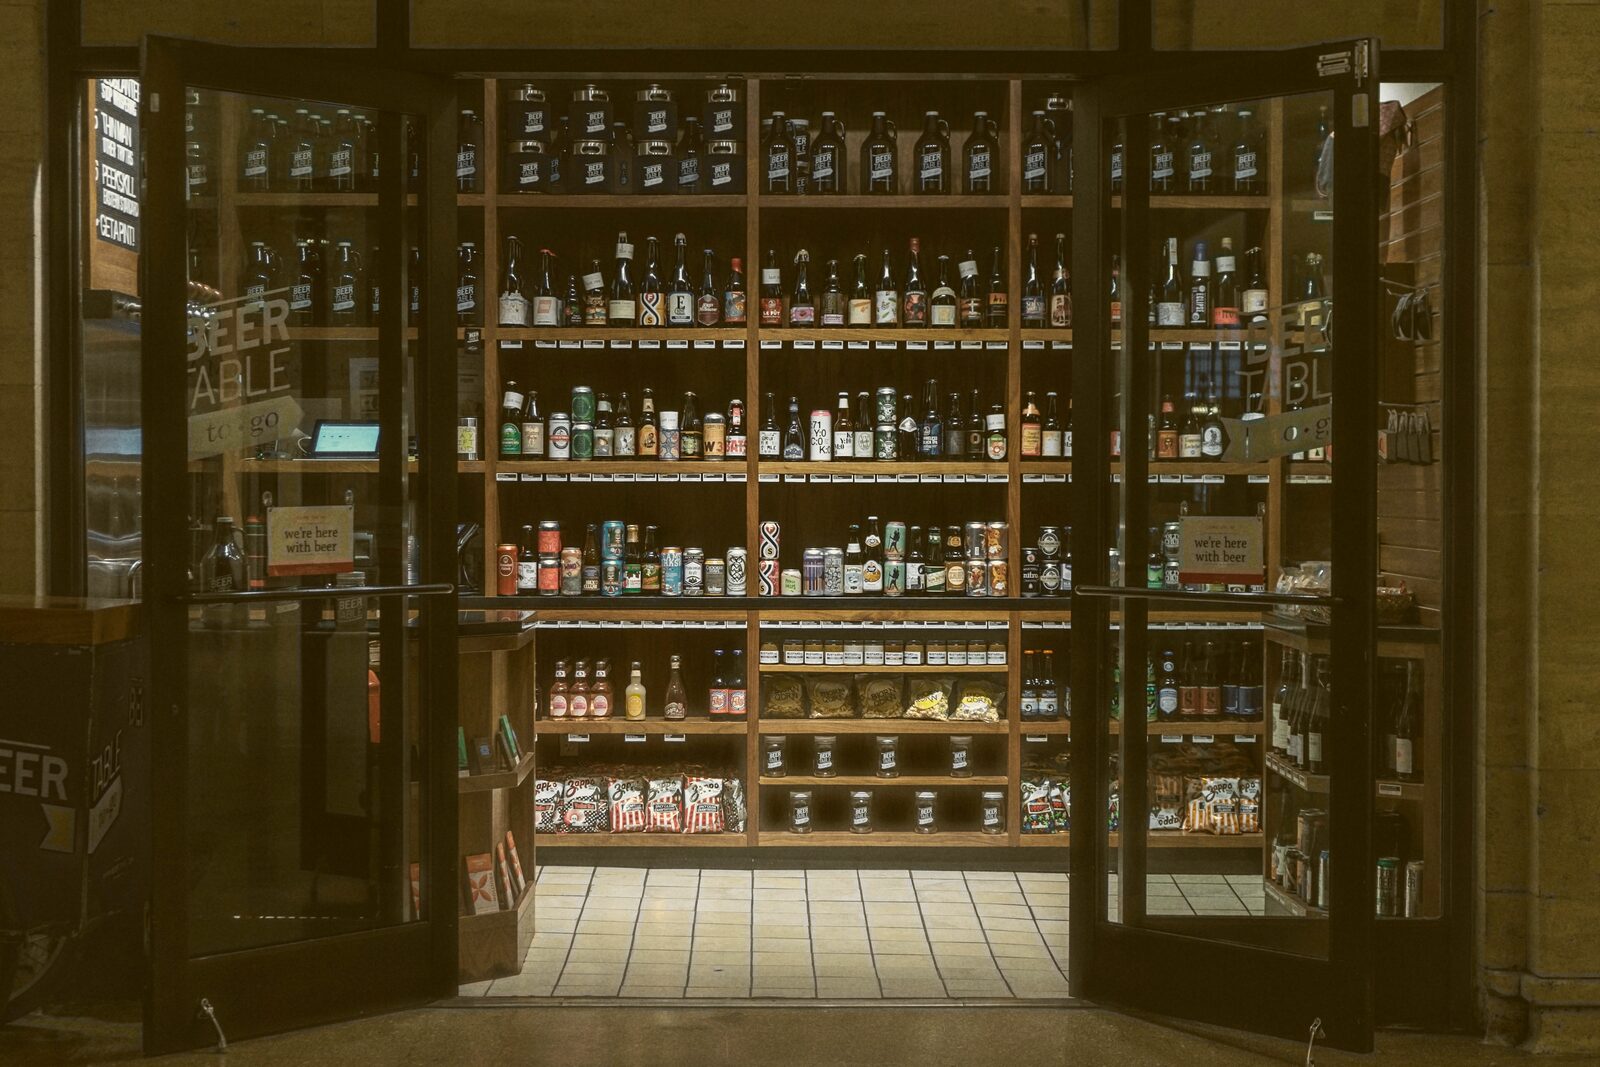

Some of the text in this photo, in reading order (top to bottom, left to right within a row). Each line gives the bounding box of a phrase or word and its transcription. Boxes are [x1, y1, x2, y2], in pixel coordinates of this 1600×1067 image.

[528, 111, 543, 119] BEER
[589, 111, 604, 119] BEER
[651, 111, 666, 119] BEER
[716, 111, 732, 119] BEER
[248, 151, 265, 161] BEER
[294, 151, 312, 161] BEER
[332, 151, 350, 161] BEER
[457, 152, 475, 162] BEER
[771, 153, 789, 163] BEER
[815, 153, 832, 163] BEER
[875, 153, 892, 163] BEER
[924, 153, 941, 163] BEER
[972, 153, 990, 163] BEER
[1026, 153, 1044, 163] BEER
[1156, 153, 1173, 163] BEER
[1194, 153, 1211, 163] BEER
[1238, 153, 1256, 163] BEER
[522, 163, 538, 171] BEER
[588, 162, 603, 171] BEER
[646, 164, 662, 172] BEER
[681, 159, 698, 168] BEER
[714, 163, 730, 172] BEER
[770, 162, 788, 170] TABLE
[814, 162, 831, 170] TABLE
[873, 162, 891, 170] TABLE
[922, 162, 940, 170] TABLE
[971, 162, 989, 170] TABLE
[1026, 162, 1043, 170] TABLE
[102, 164, 136, 198] PEEKSKILL
[293, 285, 312, 297] BEER
[336, 285, 354, 297] BEER
[457, 286, 475, 297] BEER
[250, 411, 280, 438] go
[814, 429, 827, 437] Y:0
[284, 526, 338, 539] we're here
[286, 540, 337, 553] with beer
[1194, 536, 1248, 549] we're here
[1195, 550, 1246, 563] with beer
[1023, 571, 1039, 579] nitro
